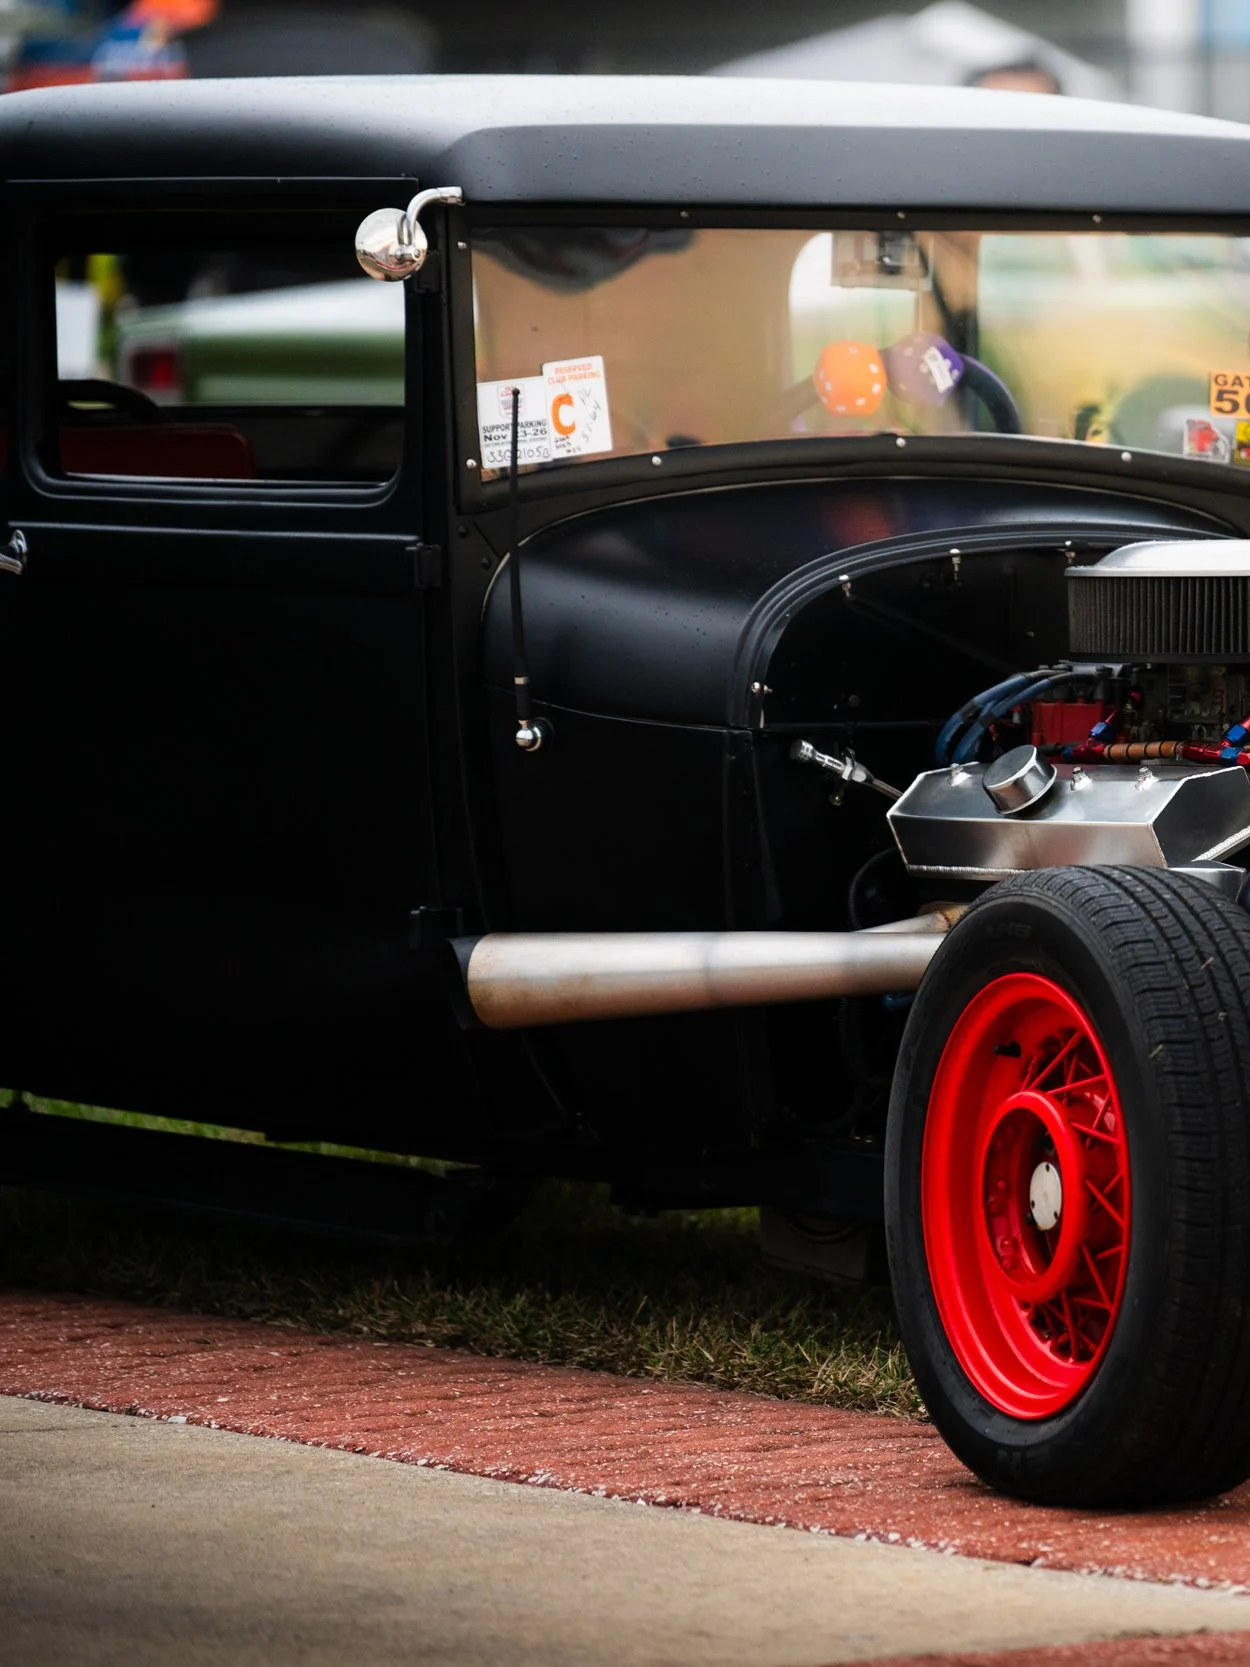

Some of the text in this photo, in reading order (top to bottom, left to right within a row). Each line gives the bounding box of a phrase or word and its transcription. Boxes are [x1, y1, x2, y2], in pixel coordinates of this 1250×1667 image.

[554, 363, 592, 374] RESERVED
[548, 370, 601, 385] CLUB PARKING
[551, 393, 576, 436] C
[484, 434, 508, 442] Nov
[512, 427, 548, 438] 3-26
